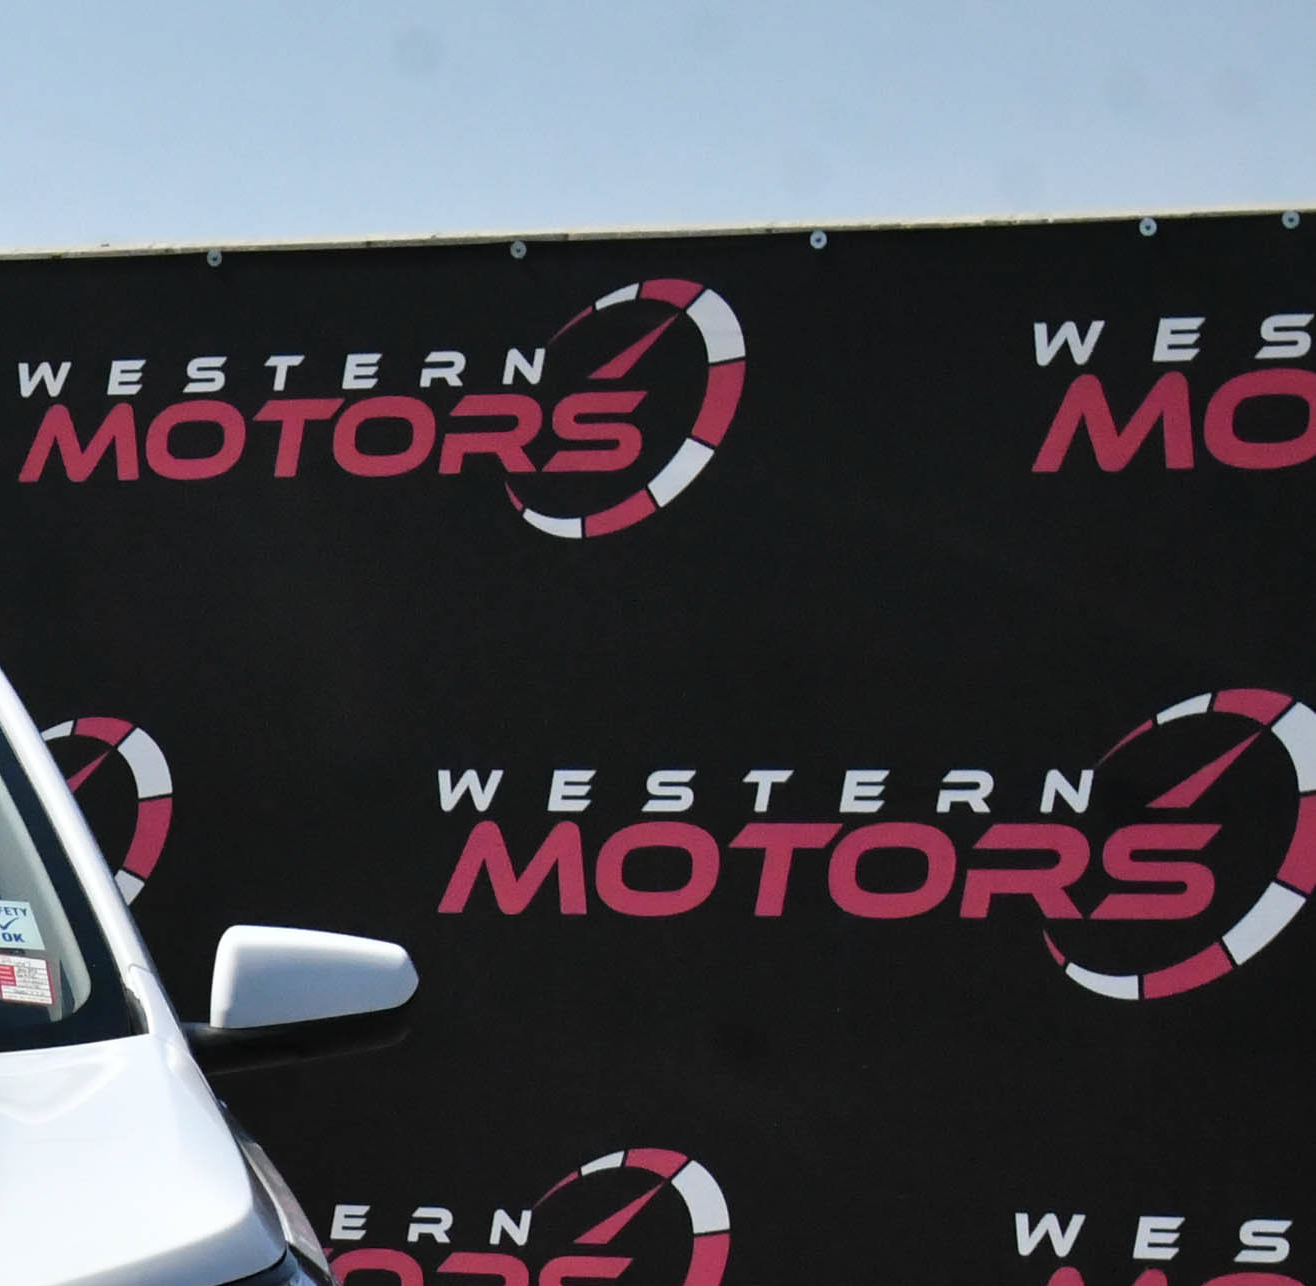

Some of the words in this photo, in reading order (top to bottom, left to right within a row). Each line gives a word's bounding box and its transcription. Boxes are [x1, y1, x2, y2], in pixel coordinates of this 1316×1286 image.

[1033, 313, 1316, 367] WES
[18, 348, 546, 398] WESTERN
[18, 390, 648, 483] MOTORS
[1031, 367, 1316, 473] MO
[437, 769, 1095, 814] WESTERN
[437, 819, 1223, 921] MOTORS
[1, 932, 25, 943] OK
[329, 1204, 533, 1247] ERN
[1014, 1212, 1293, 1264] WES
